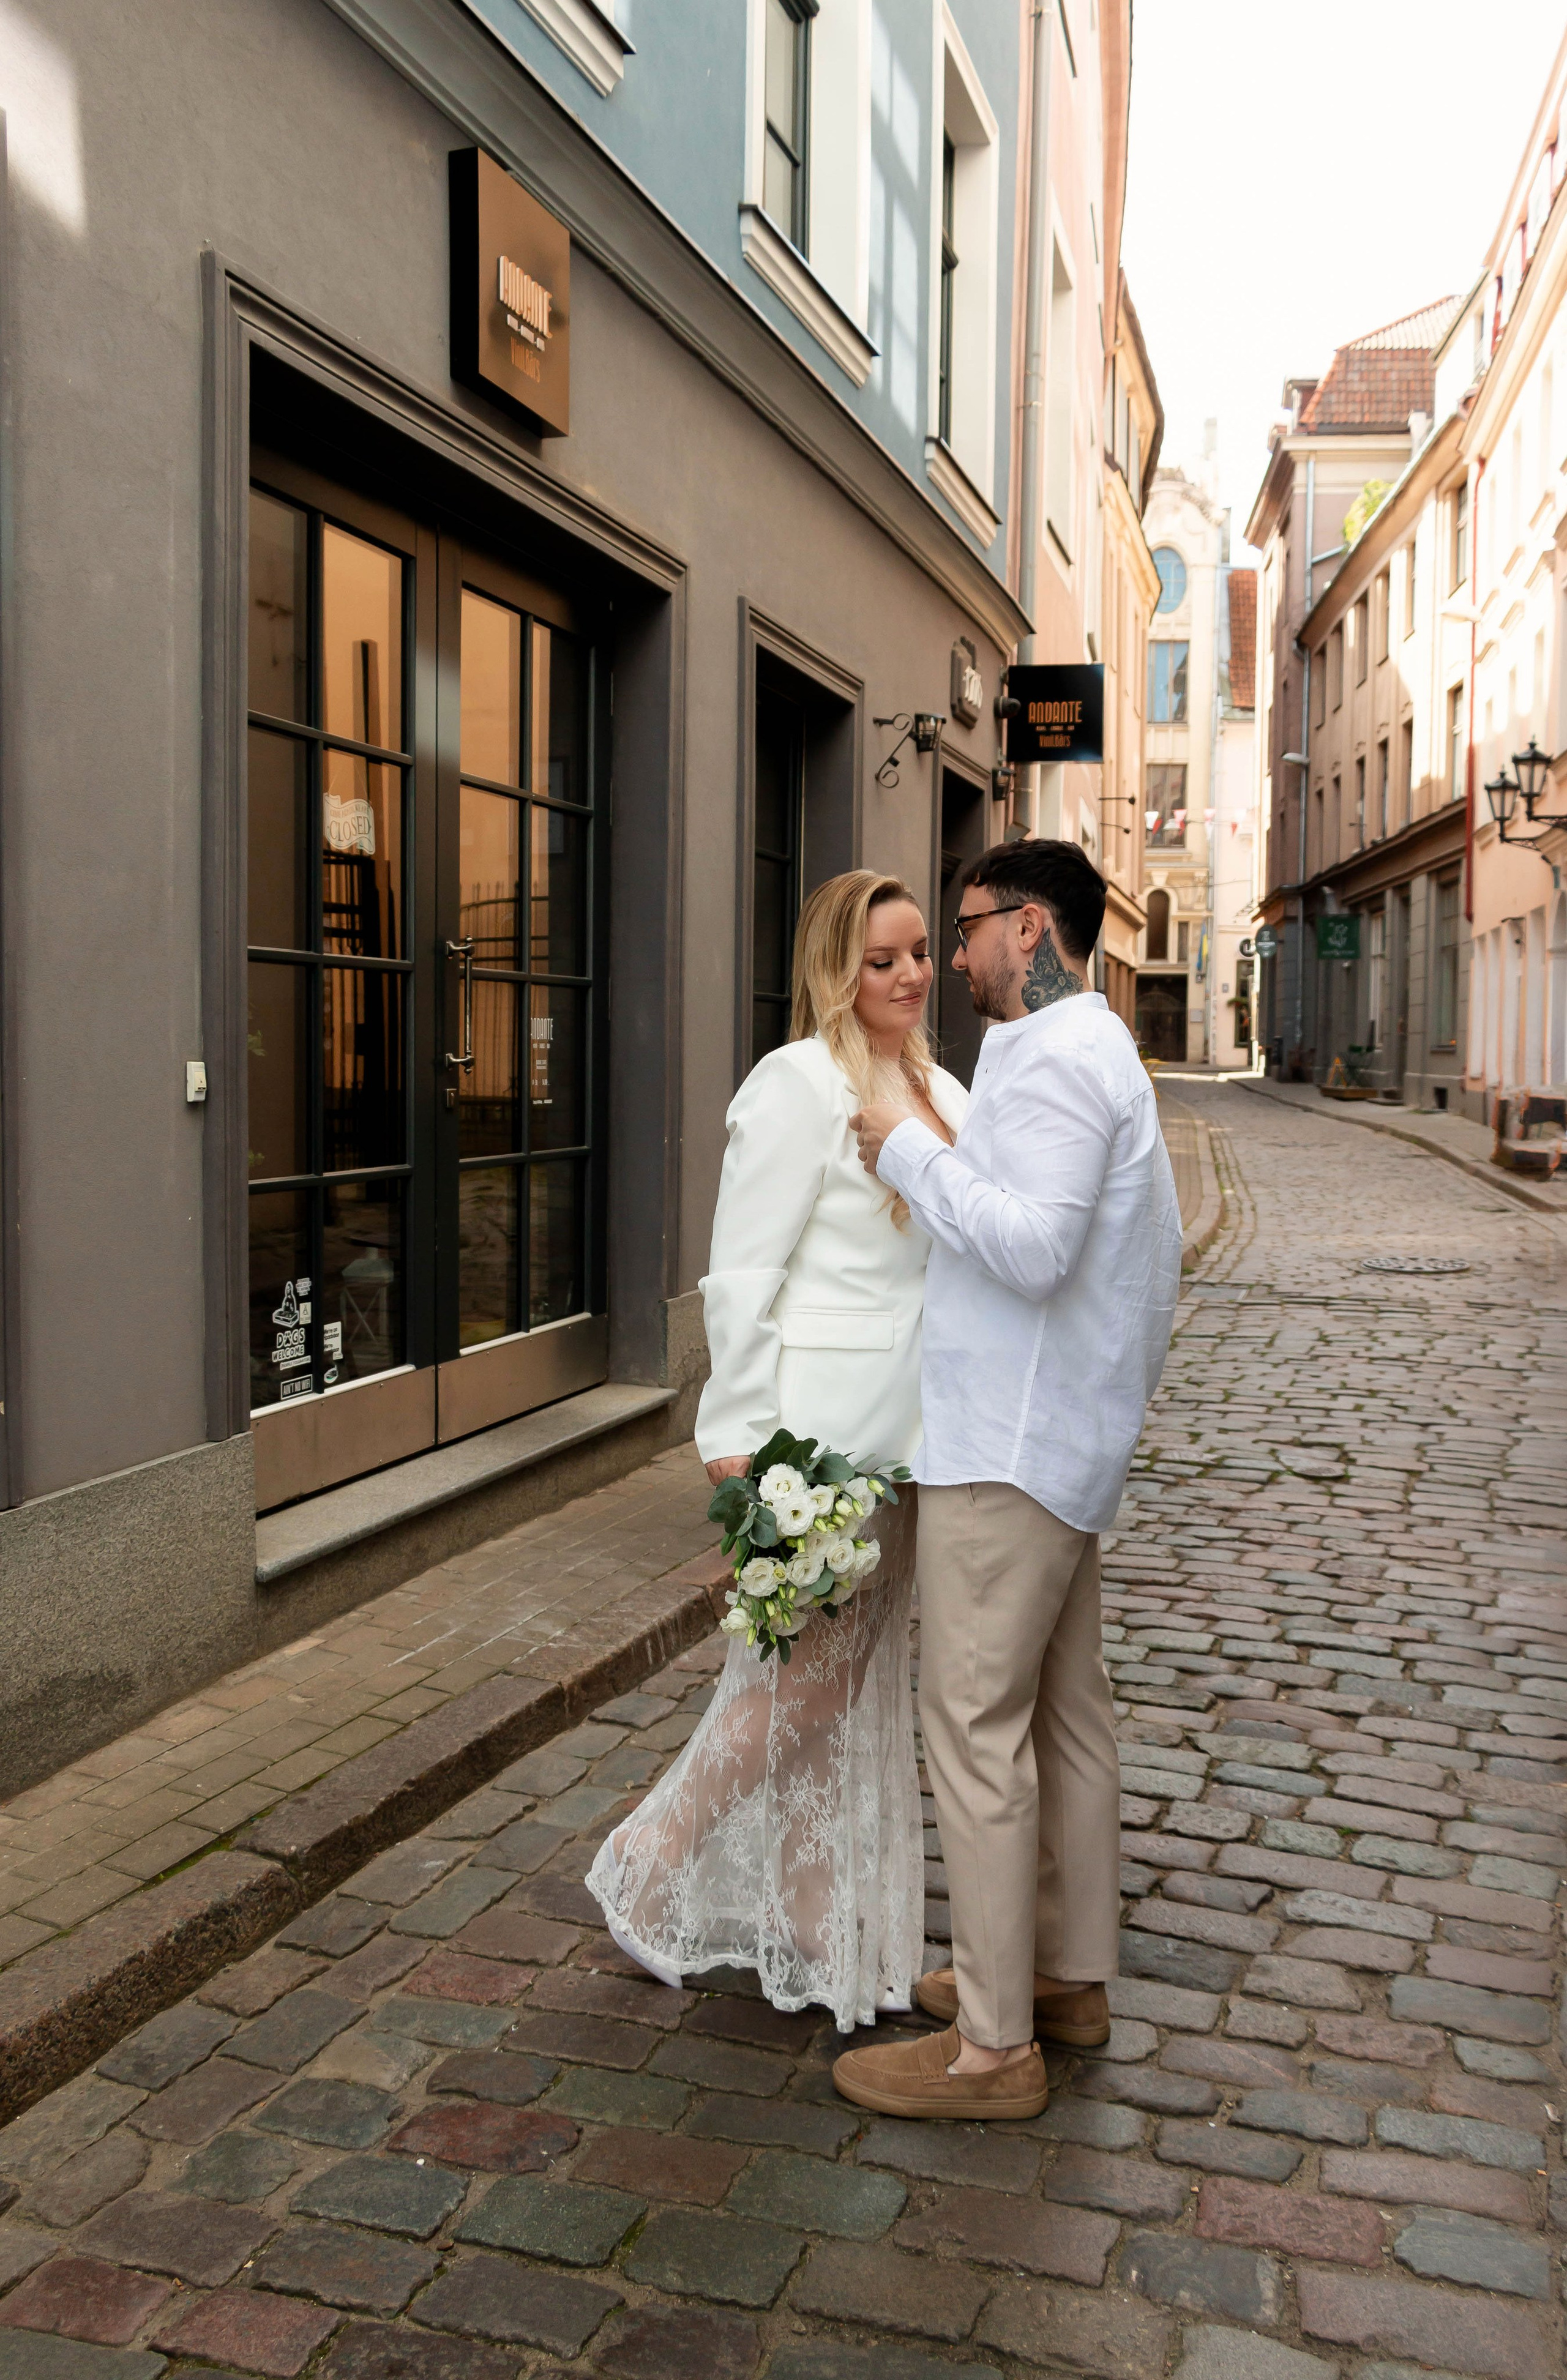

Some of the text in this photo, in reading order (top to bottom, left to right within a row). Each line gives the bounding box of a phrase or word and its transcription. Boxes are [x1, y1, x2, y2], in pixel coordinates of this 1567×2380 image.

[1028, 701, 1082, 723] ANDANTE
[330, 816, 370, 841] CLOSED
[273, 1345, 304, 1360] WELCOME
